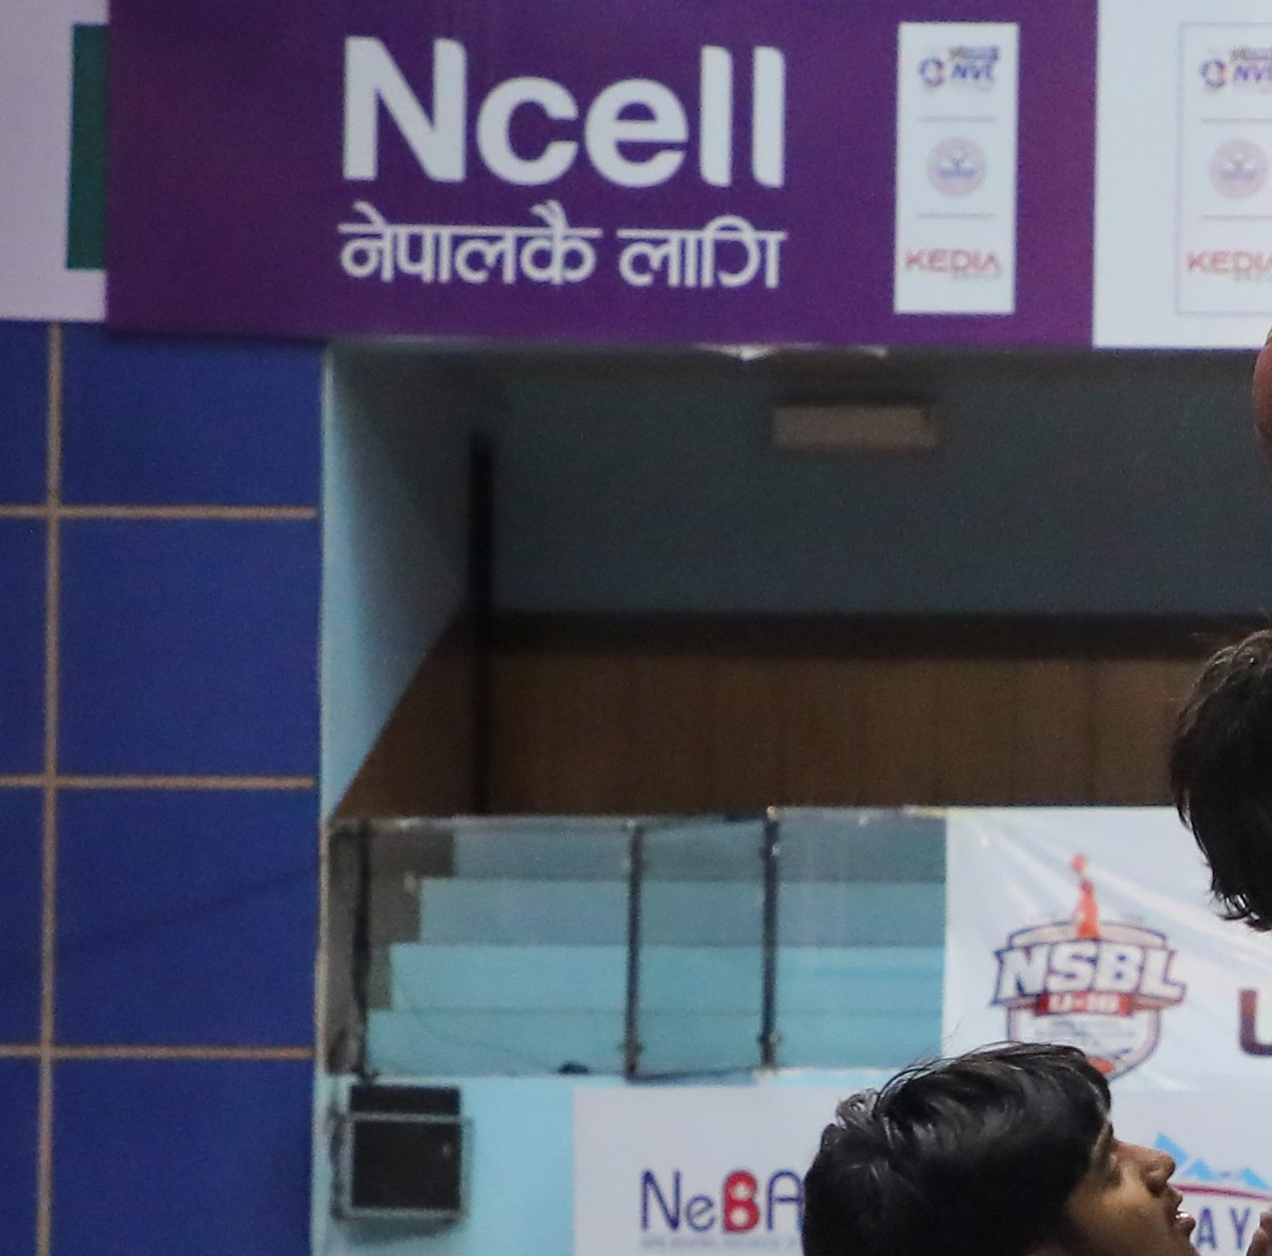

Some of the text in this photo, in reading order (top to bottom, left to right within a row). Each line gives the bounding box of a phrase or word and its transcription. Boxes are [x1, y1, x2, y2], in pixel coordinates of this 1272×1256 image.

[343, 35, 786, 188] Ncell
[337, 199, 788, 289] नेपालकै लागि
[992, 938, 1186, 1005] NSBL
[640, 1168, 806, 1233] NeBA
